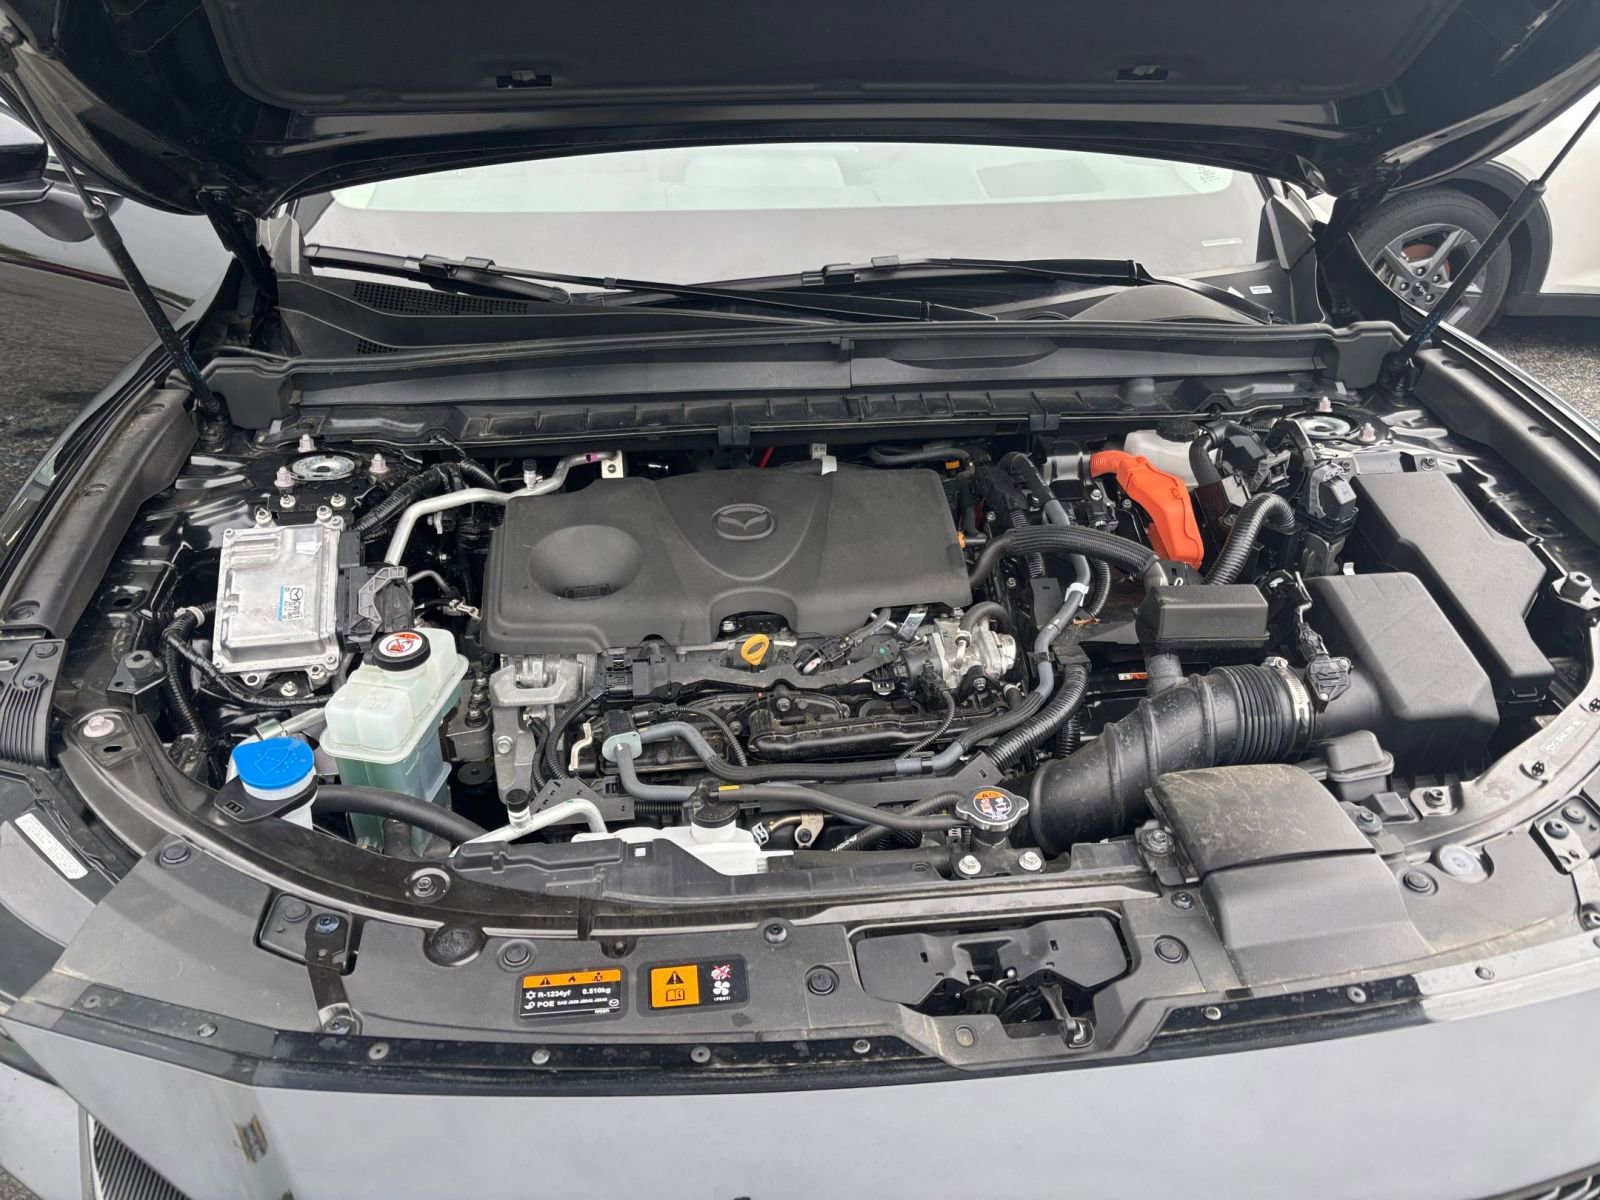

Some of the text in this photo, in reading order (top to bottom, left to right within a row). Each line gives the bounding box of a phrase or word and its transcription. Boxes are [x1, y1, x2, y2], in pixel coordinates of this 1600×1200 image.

[537, 987, 611, 998] R-1234yf 0.510kg
[537, 1000, 555, 1008] POE
